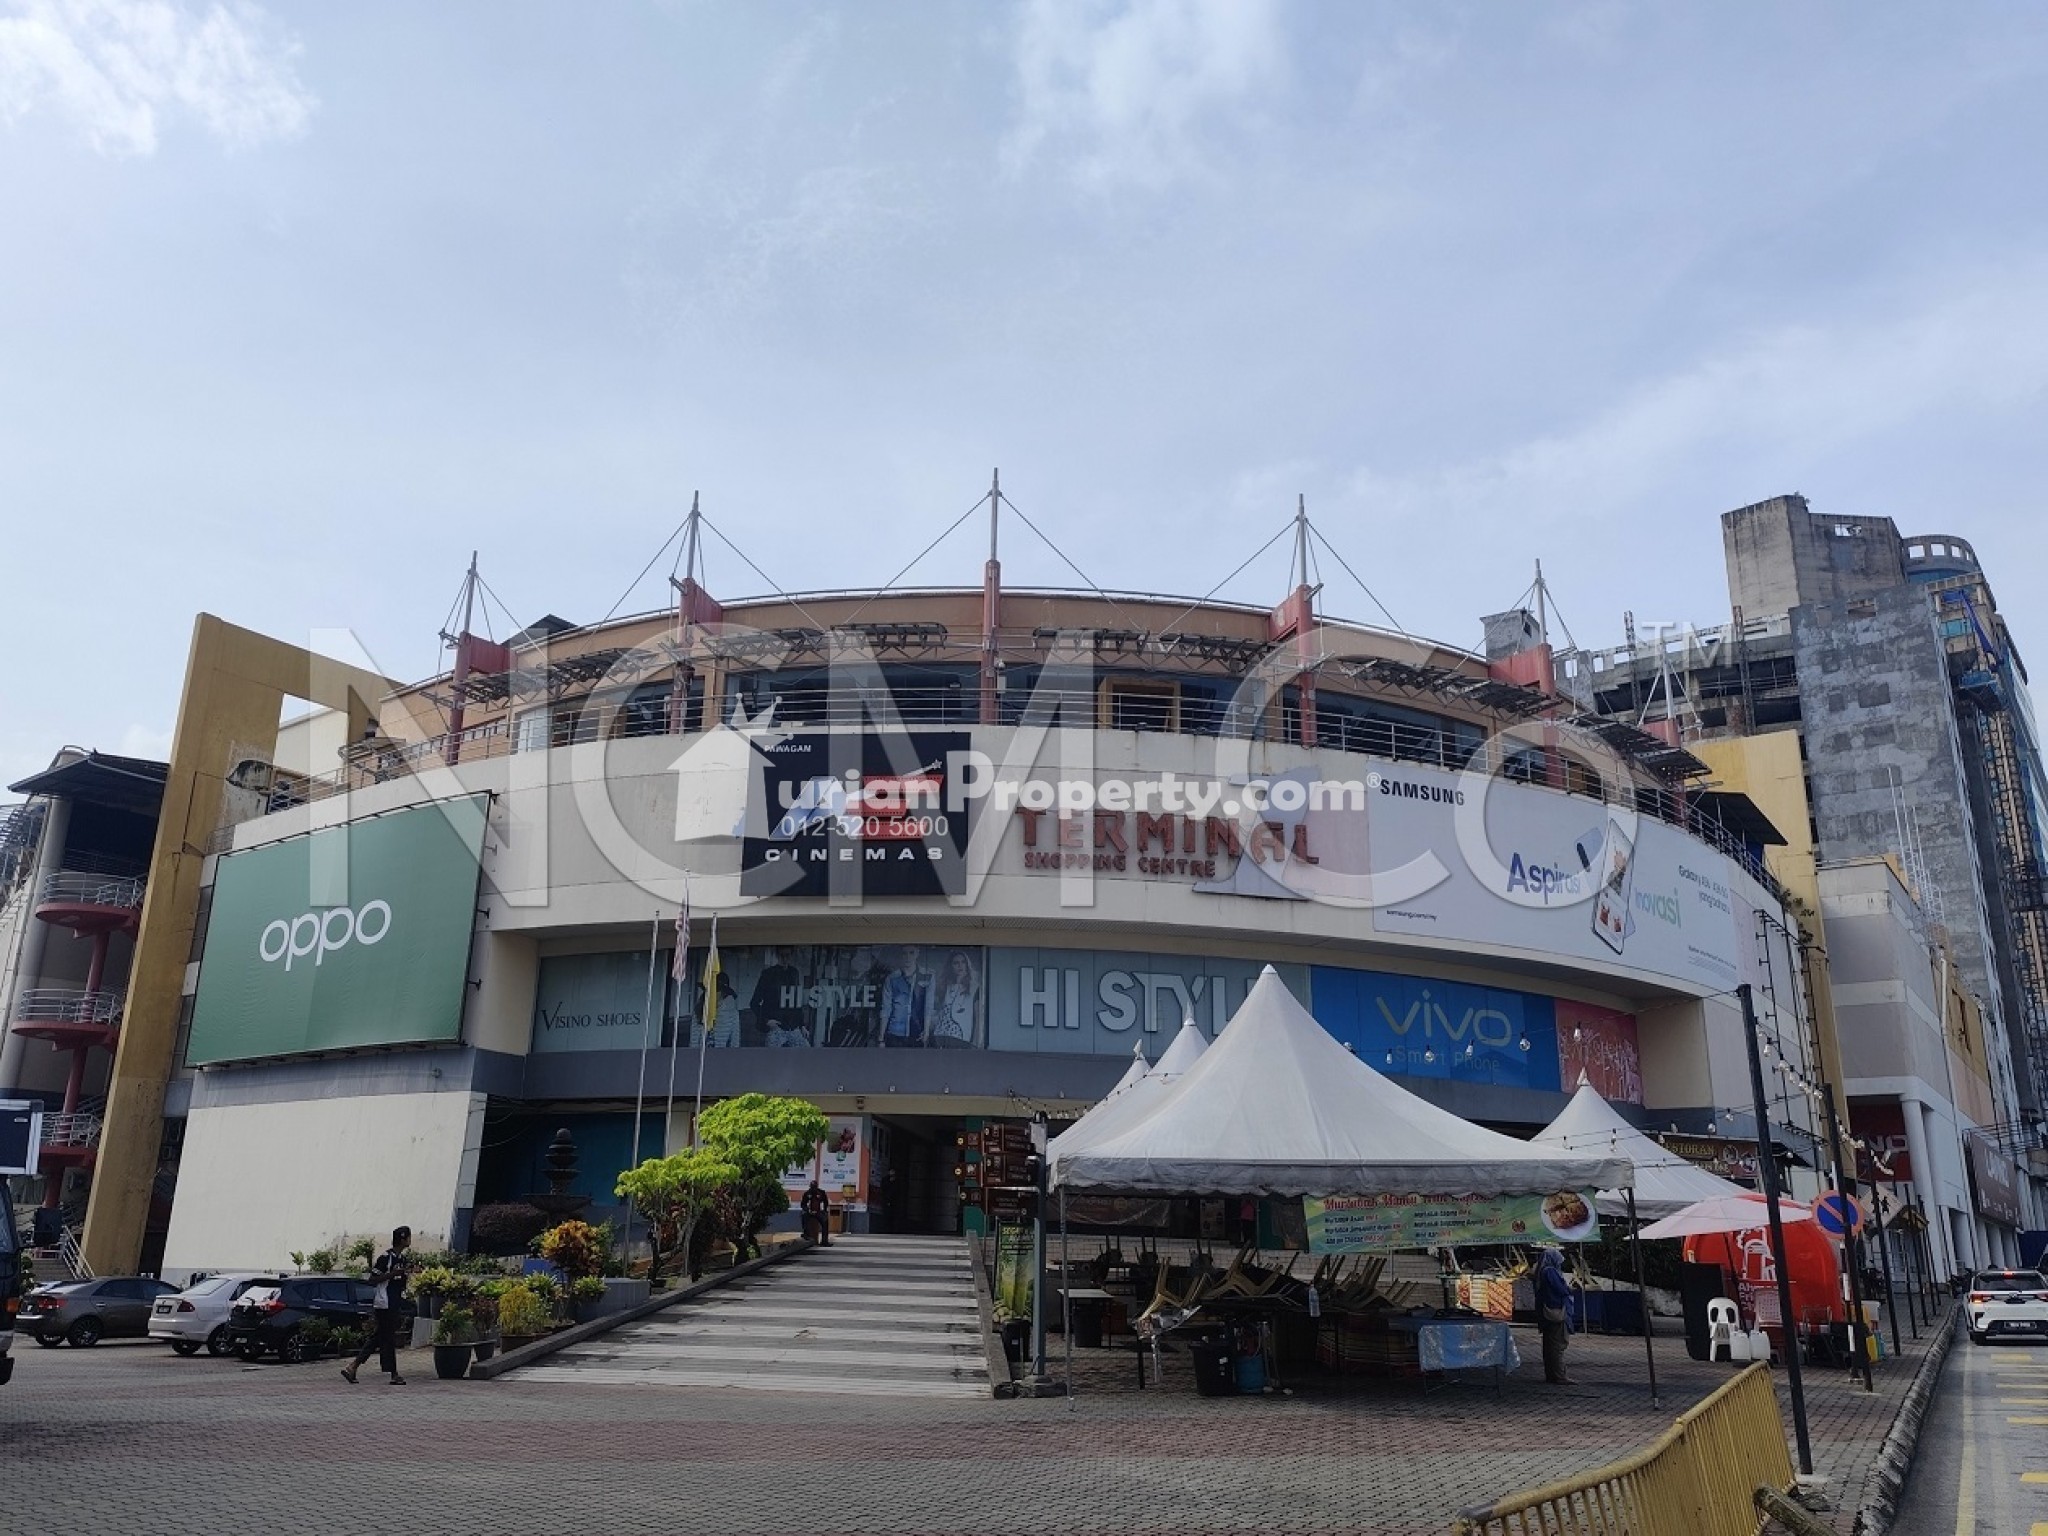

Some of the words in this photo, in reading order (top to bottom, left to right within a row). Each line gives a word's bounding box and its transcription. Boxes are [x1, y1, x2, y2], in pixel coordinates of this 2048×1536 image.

[1380, 778, 1464, 806] SAMSUNG
[1014, 806, 1320, 865] TERMINAL
[764, 847, 944, 862] CINEMAS
[1024, 852, 1126, 872] SHOPPING
[1138, 857, 1216, 877] CENTRE
[259, 898, 392, 972] oppo
[780, 984, 803, 1009] HI
[808, 984, 878, 1009] STYLE
[1019, 966, 1080, 1029] HI
[1097, 969, 1260, 1036] STYL
[595, 1012, 641, 1027] SHOES
[1376, 988, 1513, 1046] vivo
